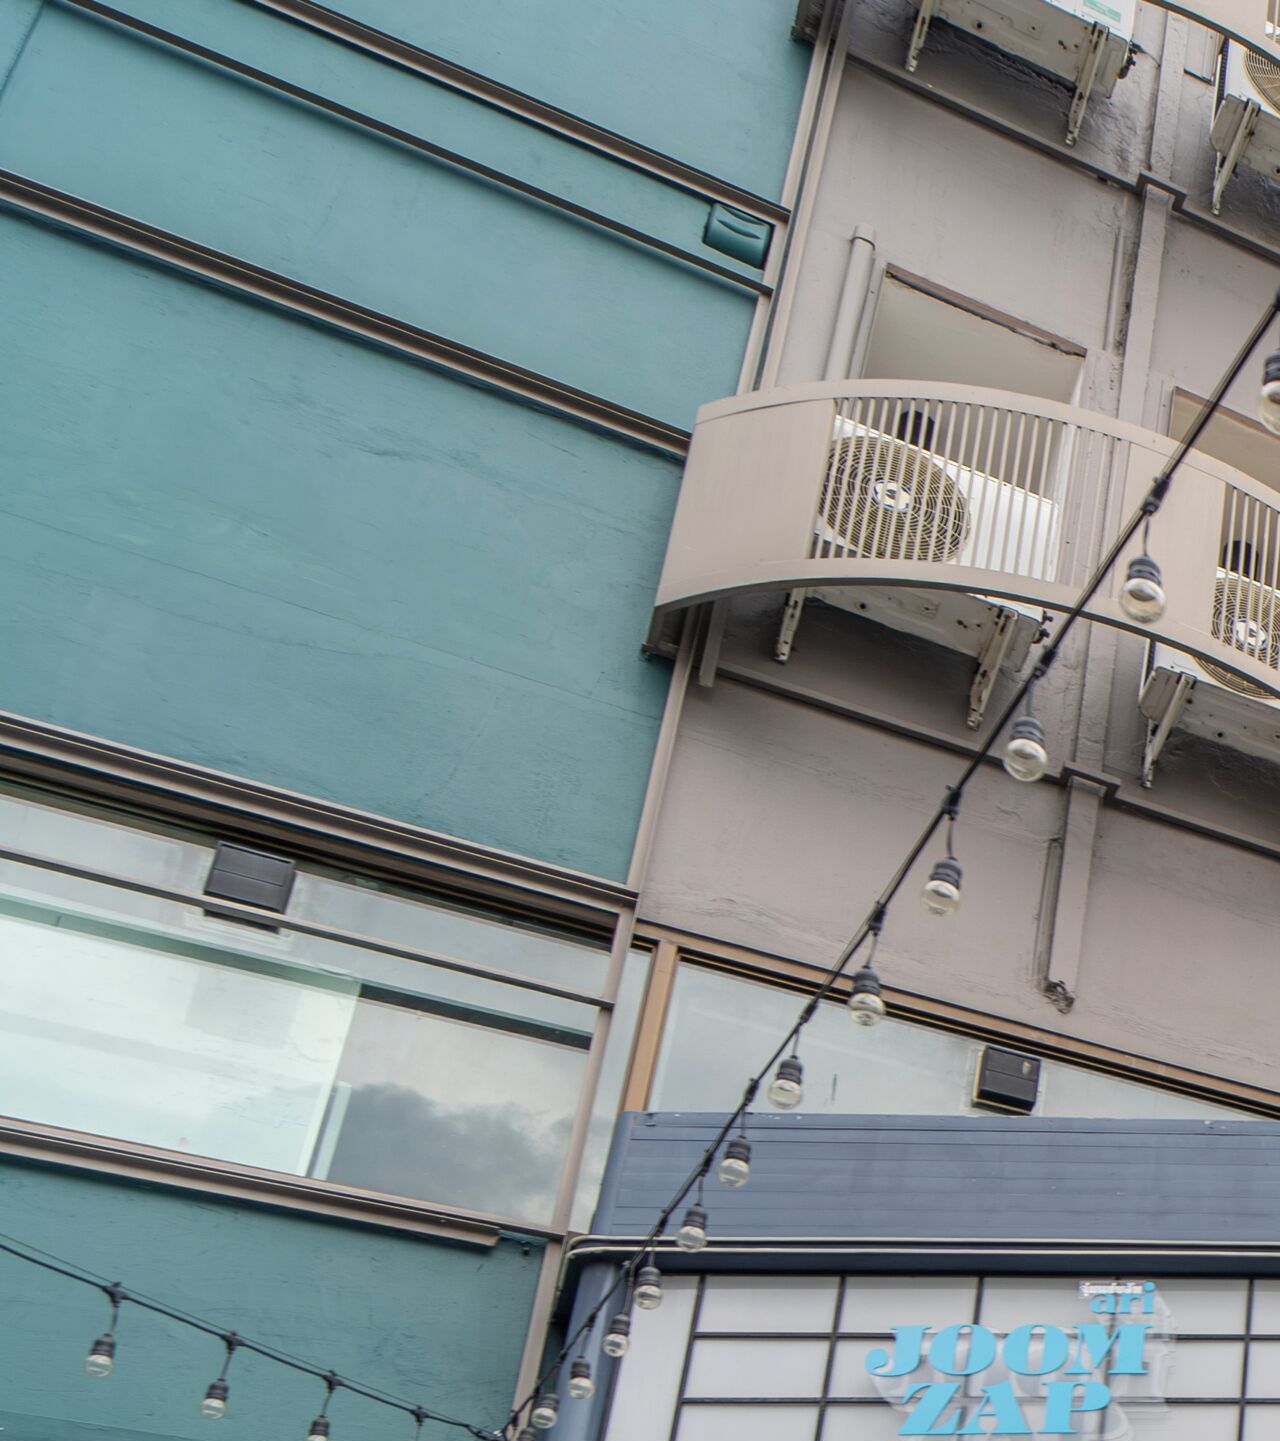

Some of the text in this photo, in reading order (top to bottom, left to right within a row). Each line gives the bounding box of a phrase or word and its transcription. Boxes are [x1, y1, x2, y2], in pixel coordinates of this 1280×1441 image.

[1090, 1281, 1155, 1314] ari
[866, 1324, 1151, 1377] JOOM
[899, 1381, 1112, 1436] ZAP
